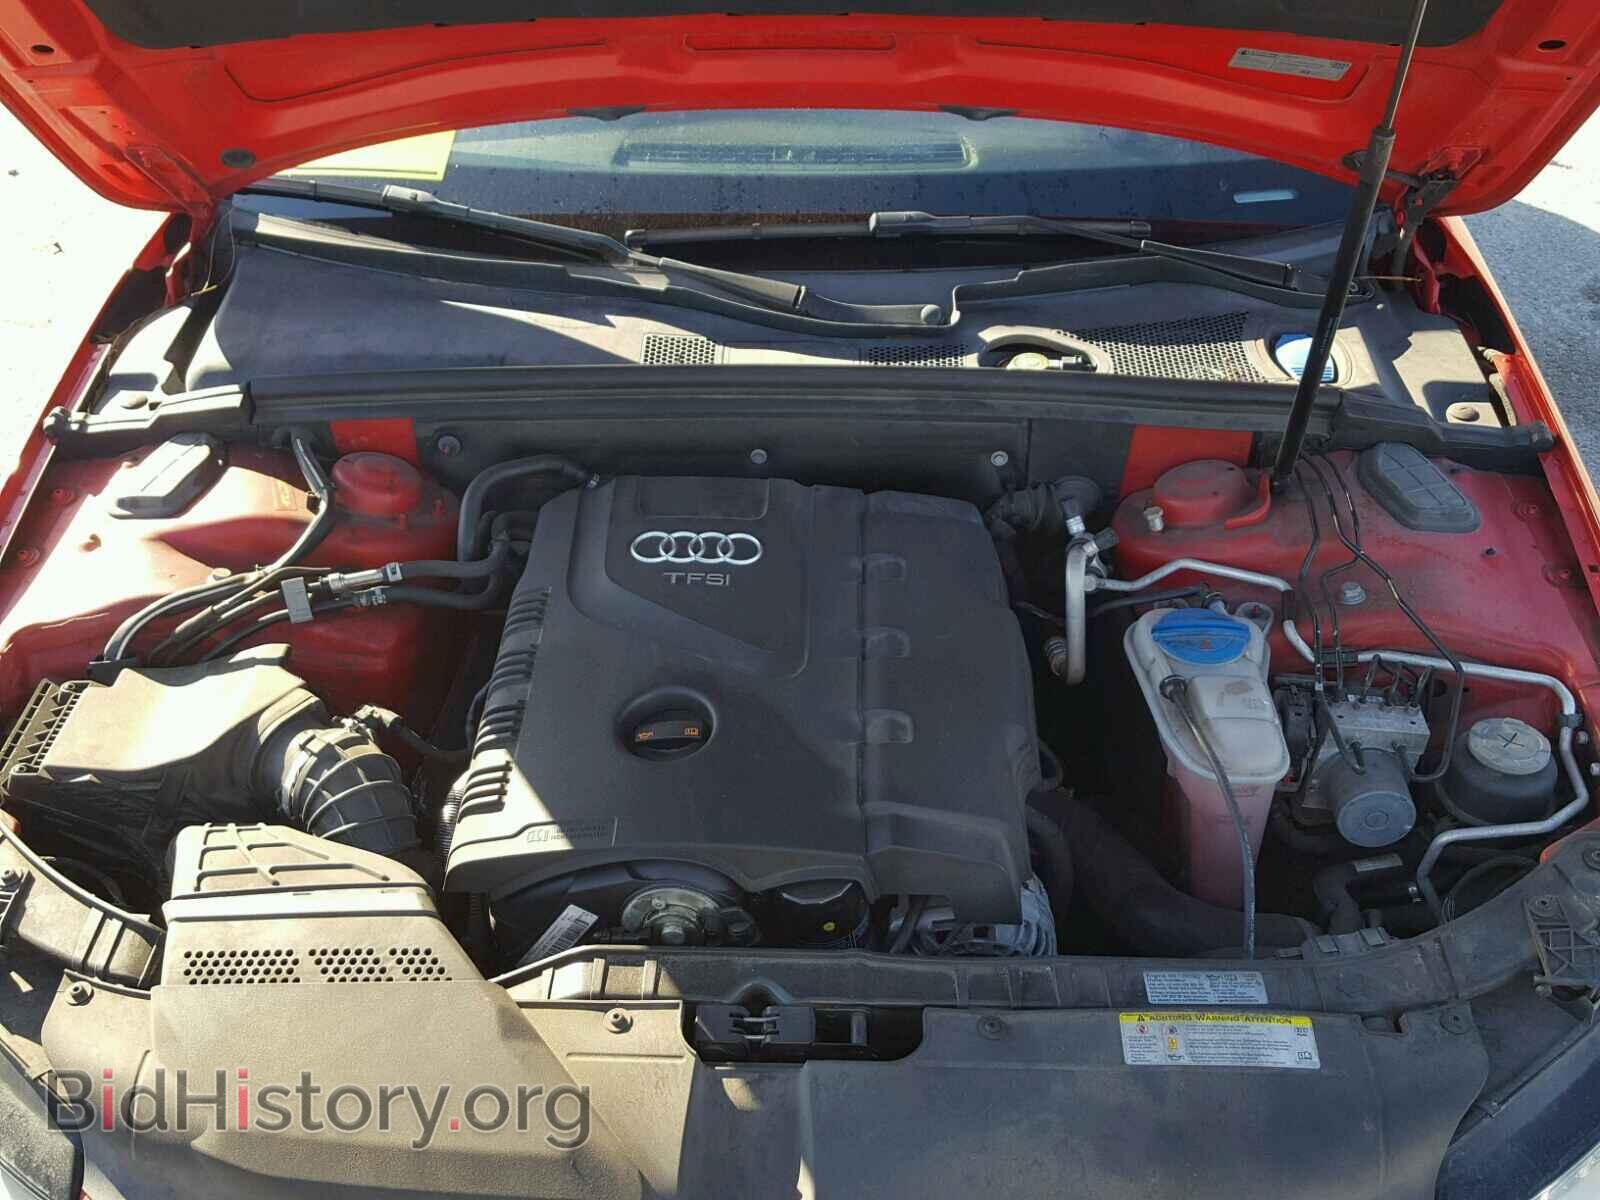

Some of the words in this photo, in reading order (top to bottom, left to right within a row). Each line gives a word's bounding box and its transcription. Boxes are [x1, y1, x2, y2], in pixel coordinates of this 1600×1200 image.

[663, 571, 731, 586] TFSI
[1196, 1014, 1240, 1023] WARNING
[1244, 1015, 1292, 1024] ATTENTION
